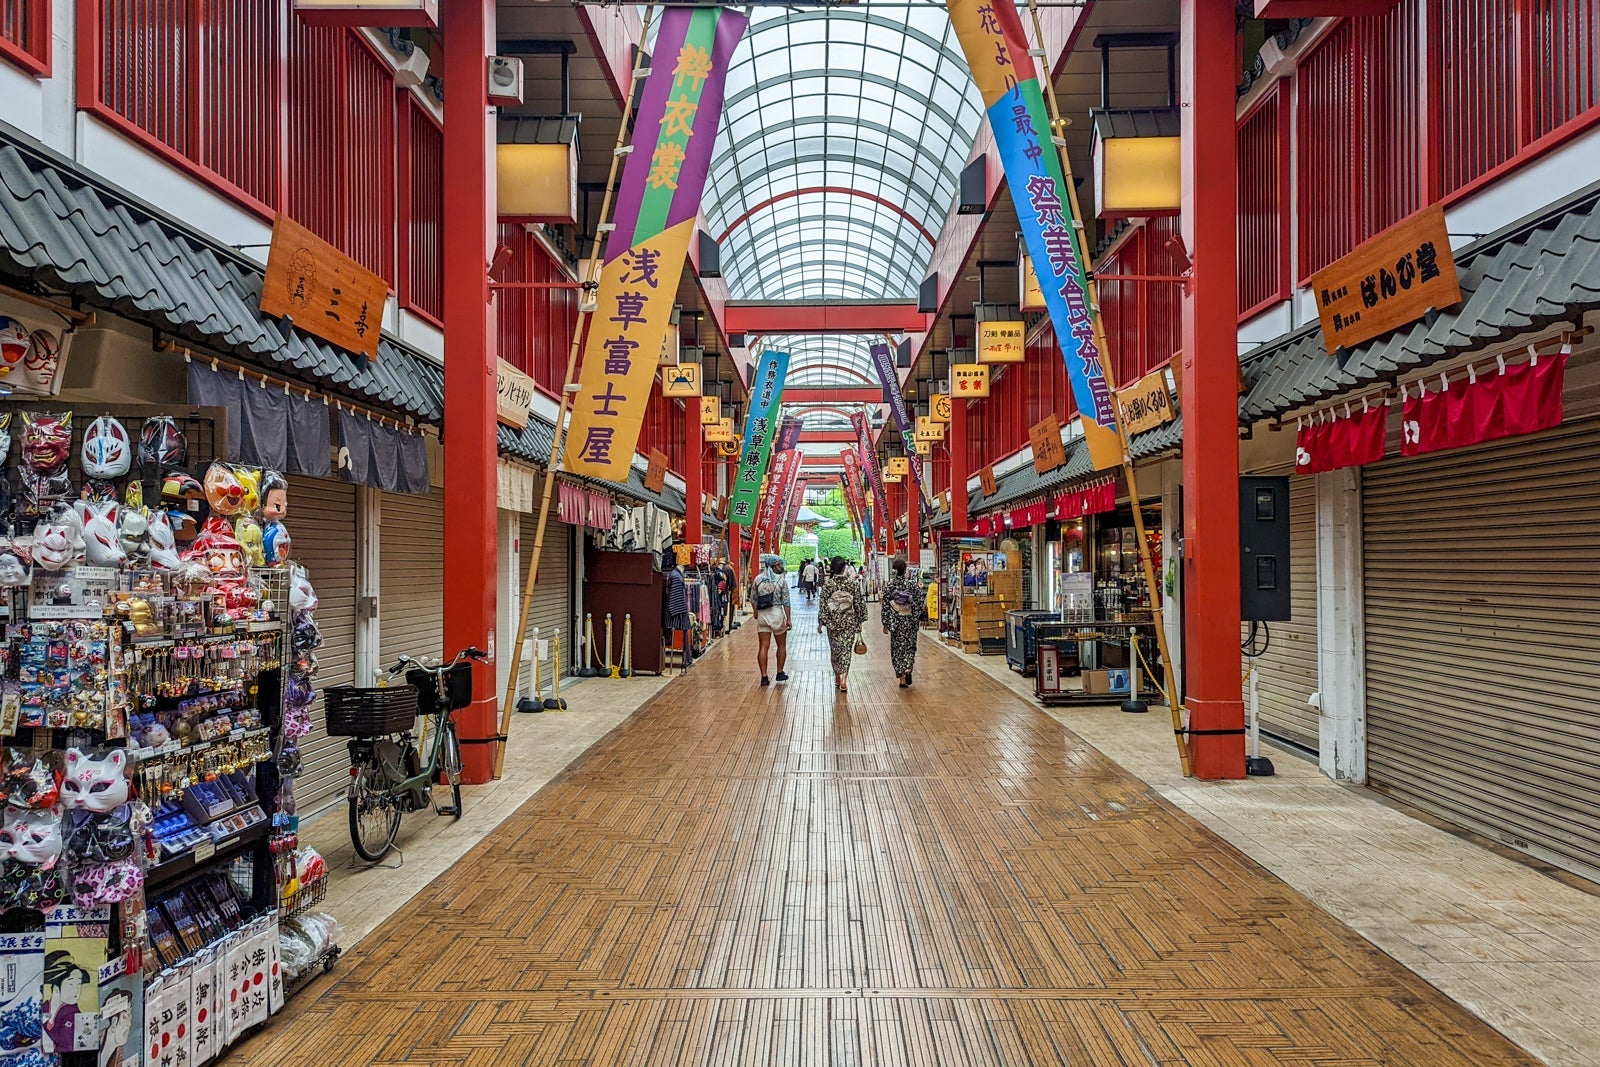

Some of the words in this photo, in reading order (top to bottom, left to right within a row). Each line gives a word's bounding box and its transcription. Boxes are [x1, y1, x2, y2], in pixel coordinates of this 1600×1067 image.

[646, 44, 713, 190] 粋衣裳
[977, 5, 1044, 170] 花より最中
[1360, 241, 1440, 309] ばんび堂
[578, 248, 661, 465] 浅草富士屋
[760, 360, 779, 410] 作務衣道中
[733, 418, 769, 517] 浅草藤衣一座
[760, 452, 789, 529] 佛羅里達製作所
